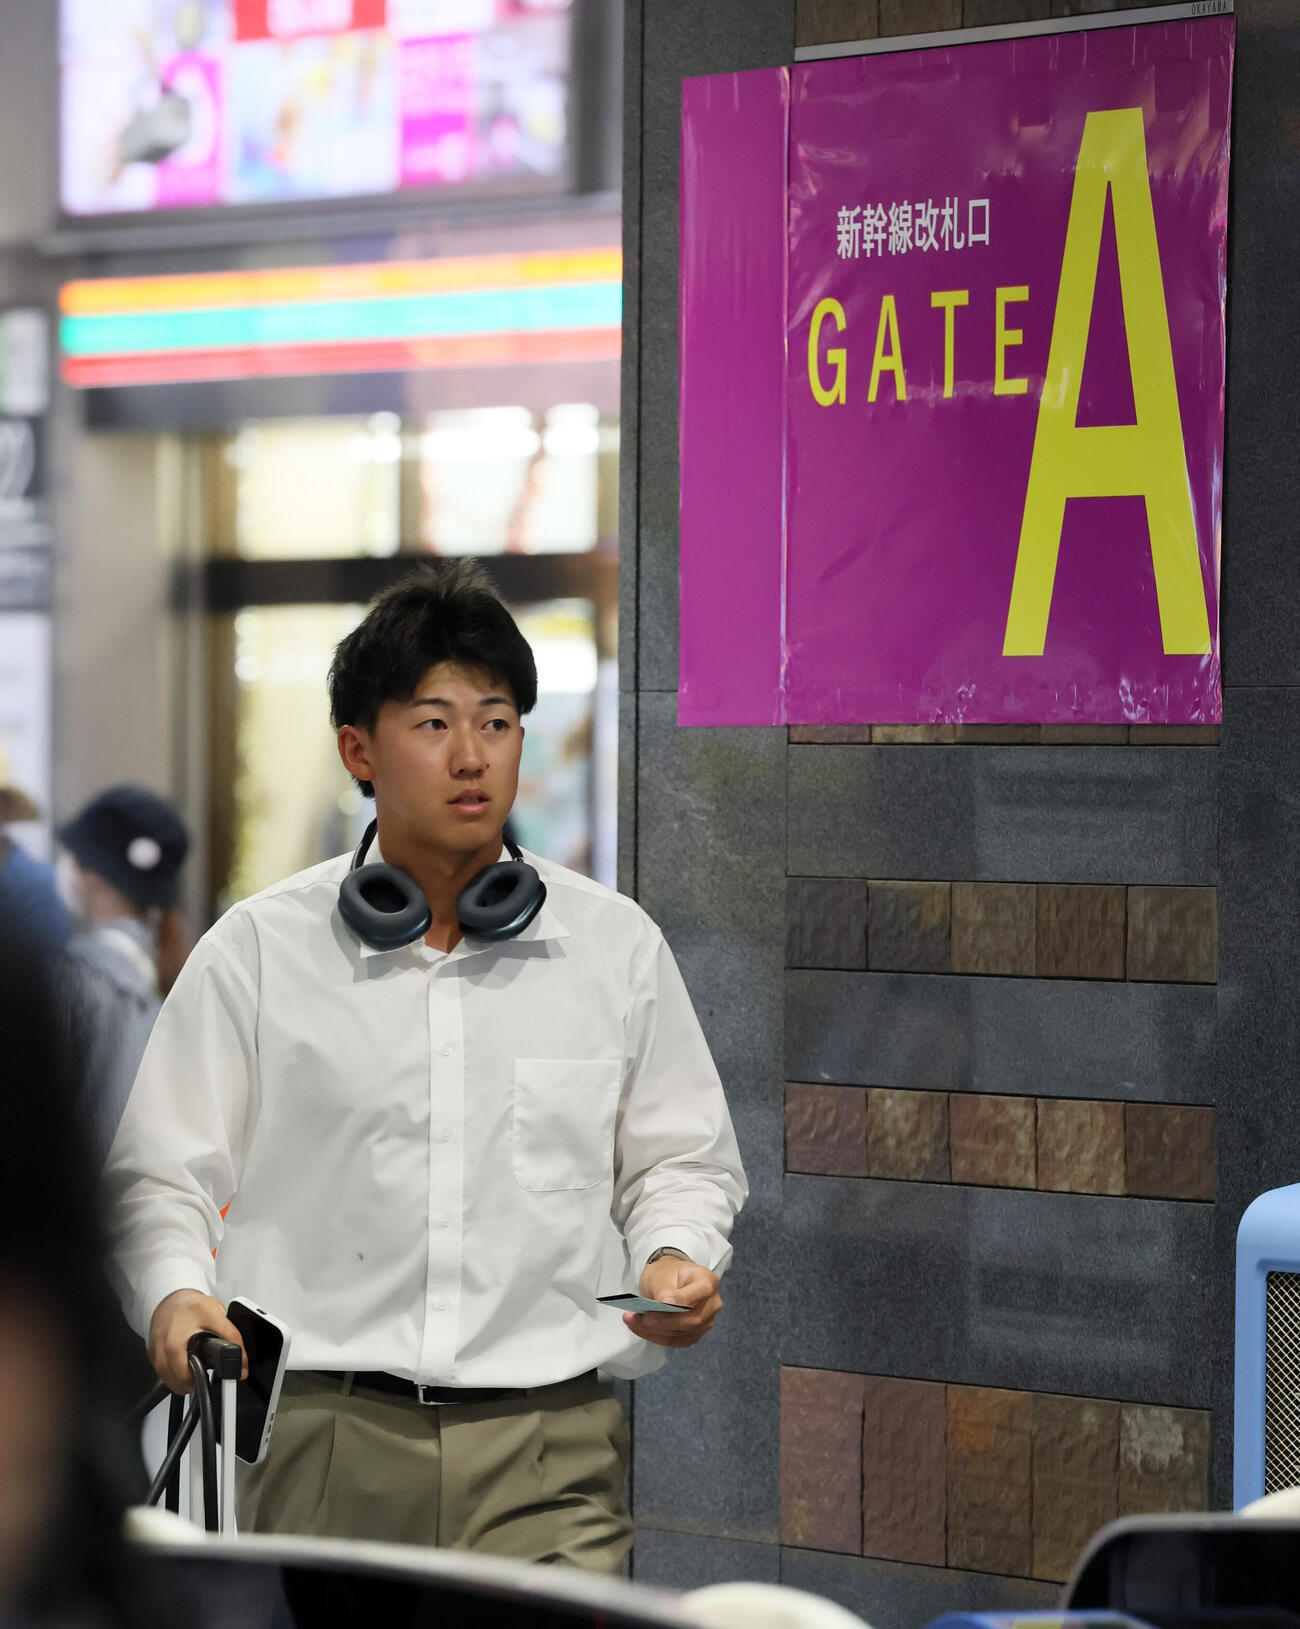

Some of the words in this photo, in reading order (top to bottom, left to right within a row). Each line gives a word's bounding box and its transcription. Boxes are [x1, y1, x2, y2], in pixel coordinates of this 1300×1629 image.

[836, 197, 990, 259] 新幹線改札口
[807, 284, 1029, 407] GATE
[1001, 106, 1212, 657] A
